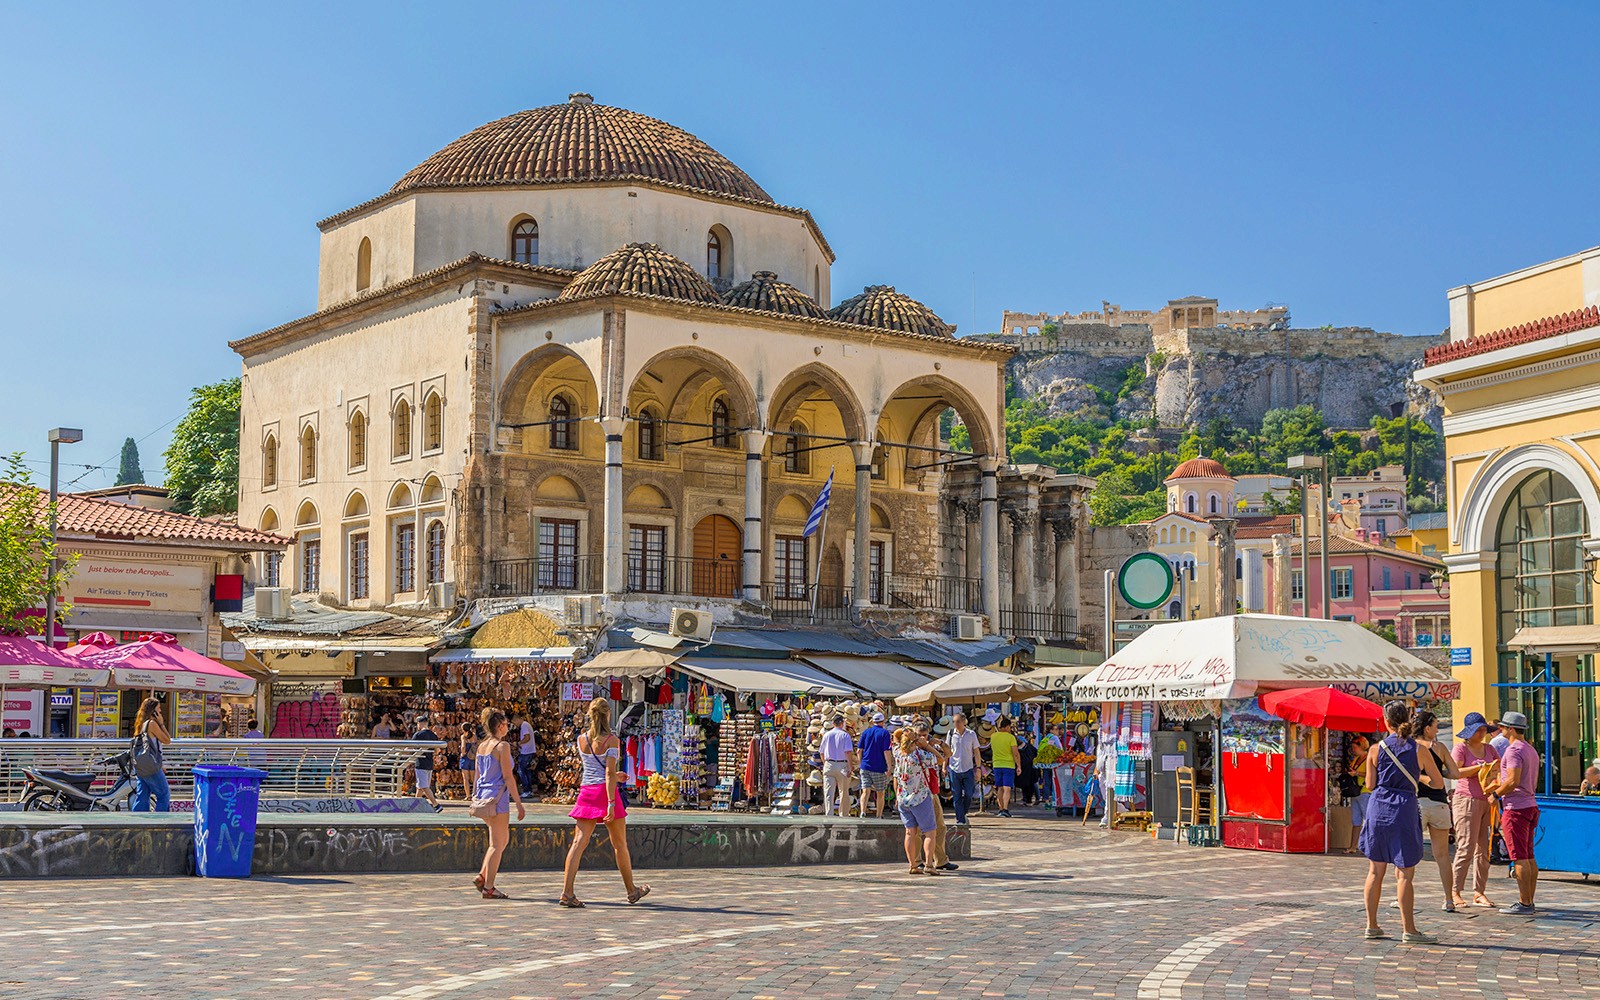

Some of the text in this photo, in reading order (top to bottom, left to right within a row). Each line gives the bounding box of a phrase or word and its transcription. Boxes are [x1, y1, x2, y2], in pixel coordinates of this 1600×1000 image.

[88, 565, 102, 573] Just
[103, 566, 124, 574] below
[99, 588, 121, 596] Tickets
[127, 589, 144, 597] Ferry
[146, 590, 168, 598] Tickets
[51, 696, 71, 704] ATM
